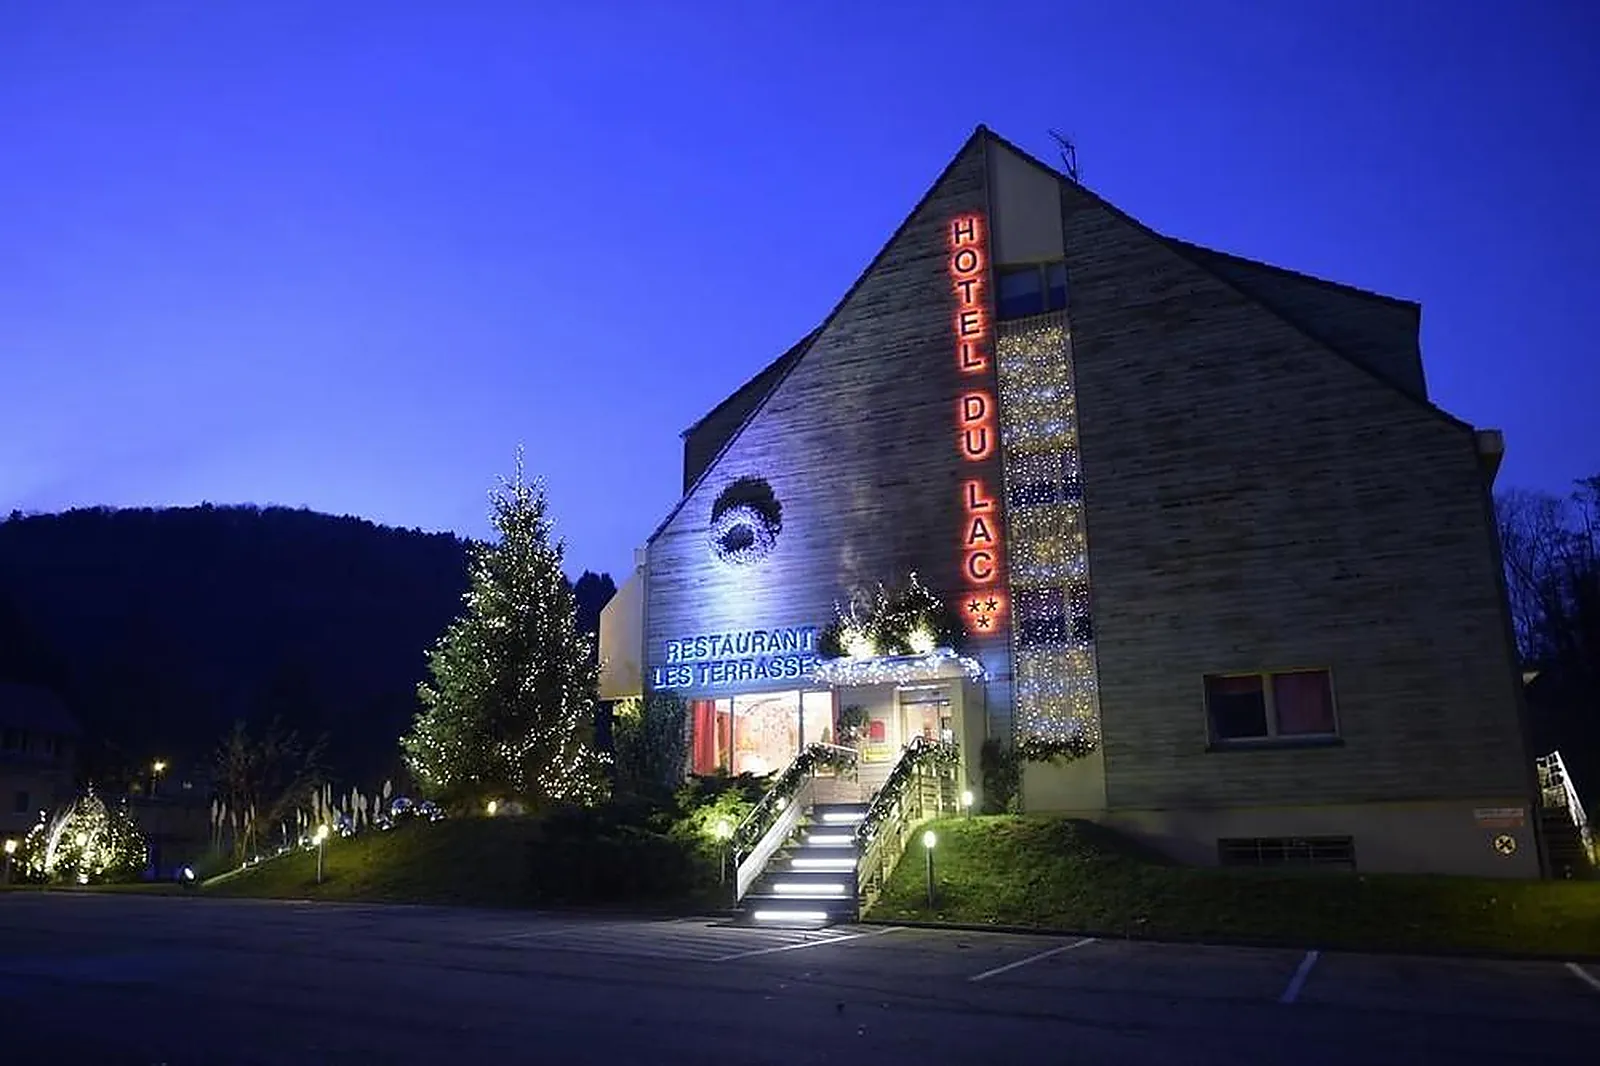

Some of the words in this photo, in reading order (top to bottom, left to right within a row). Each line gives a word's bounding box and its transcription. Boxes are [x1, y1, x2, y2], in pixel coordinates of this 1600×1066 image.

[953, 217, 982, 368] HOTEL
[963, 395, 987, 456] DU
[967, 483, 993, 581] LAC
[666, 627, 816, 661] RESTAURANT
[652, 663, 692, 688] LES
